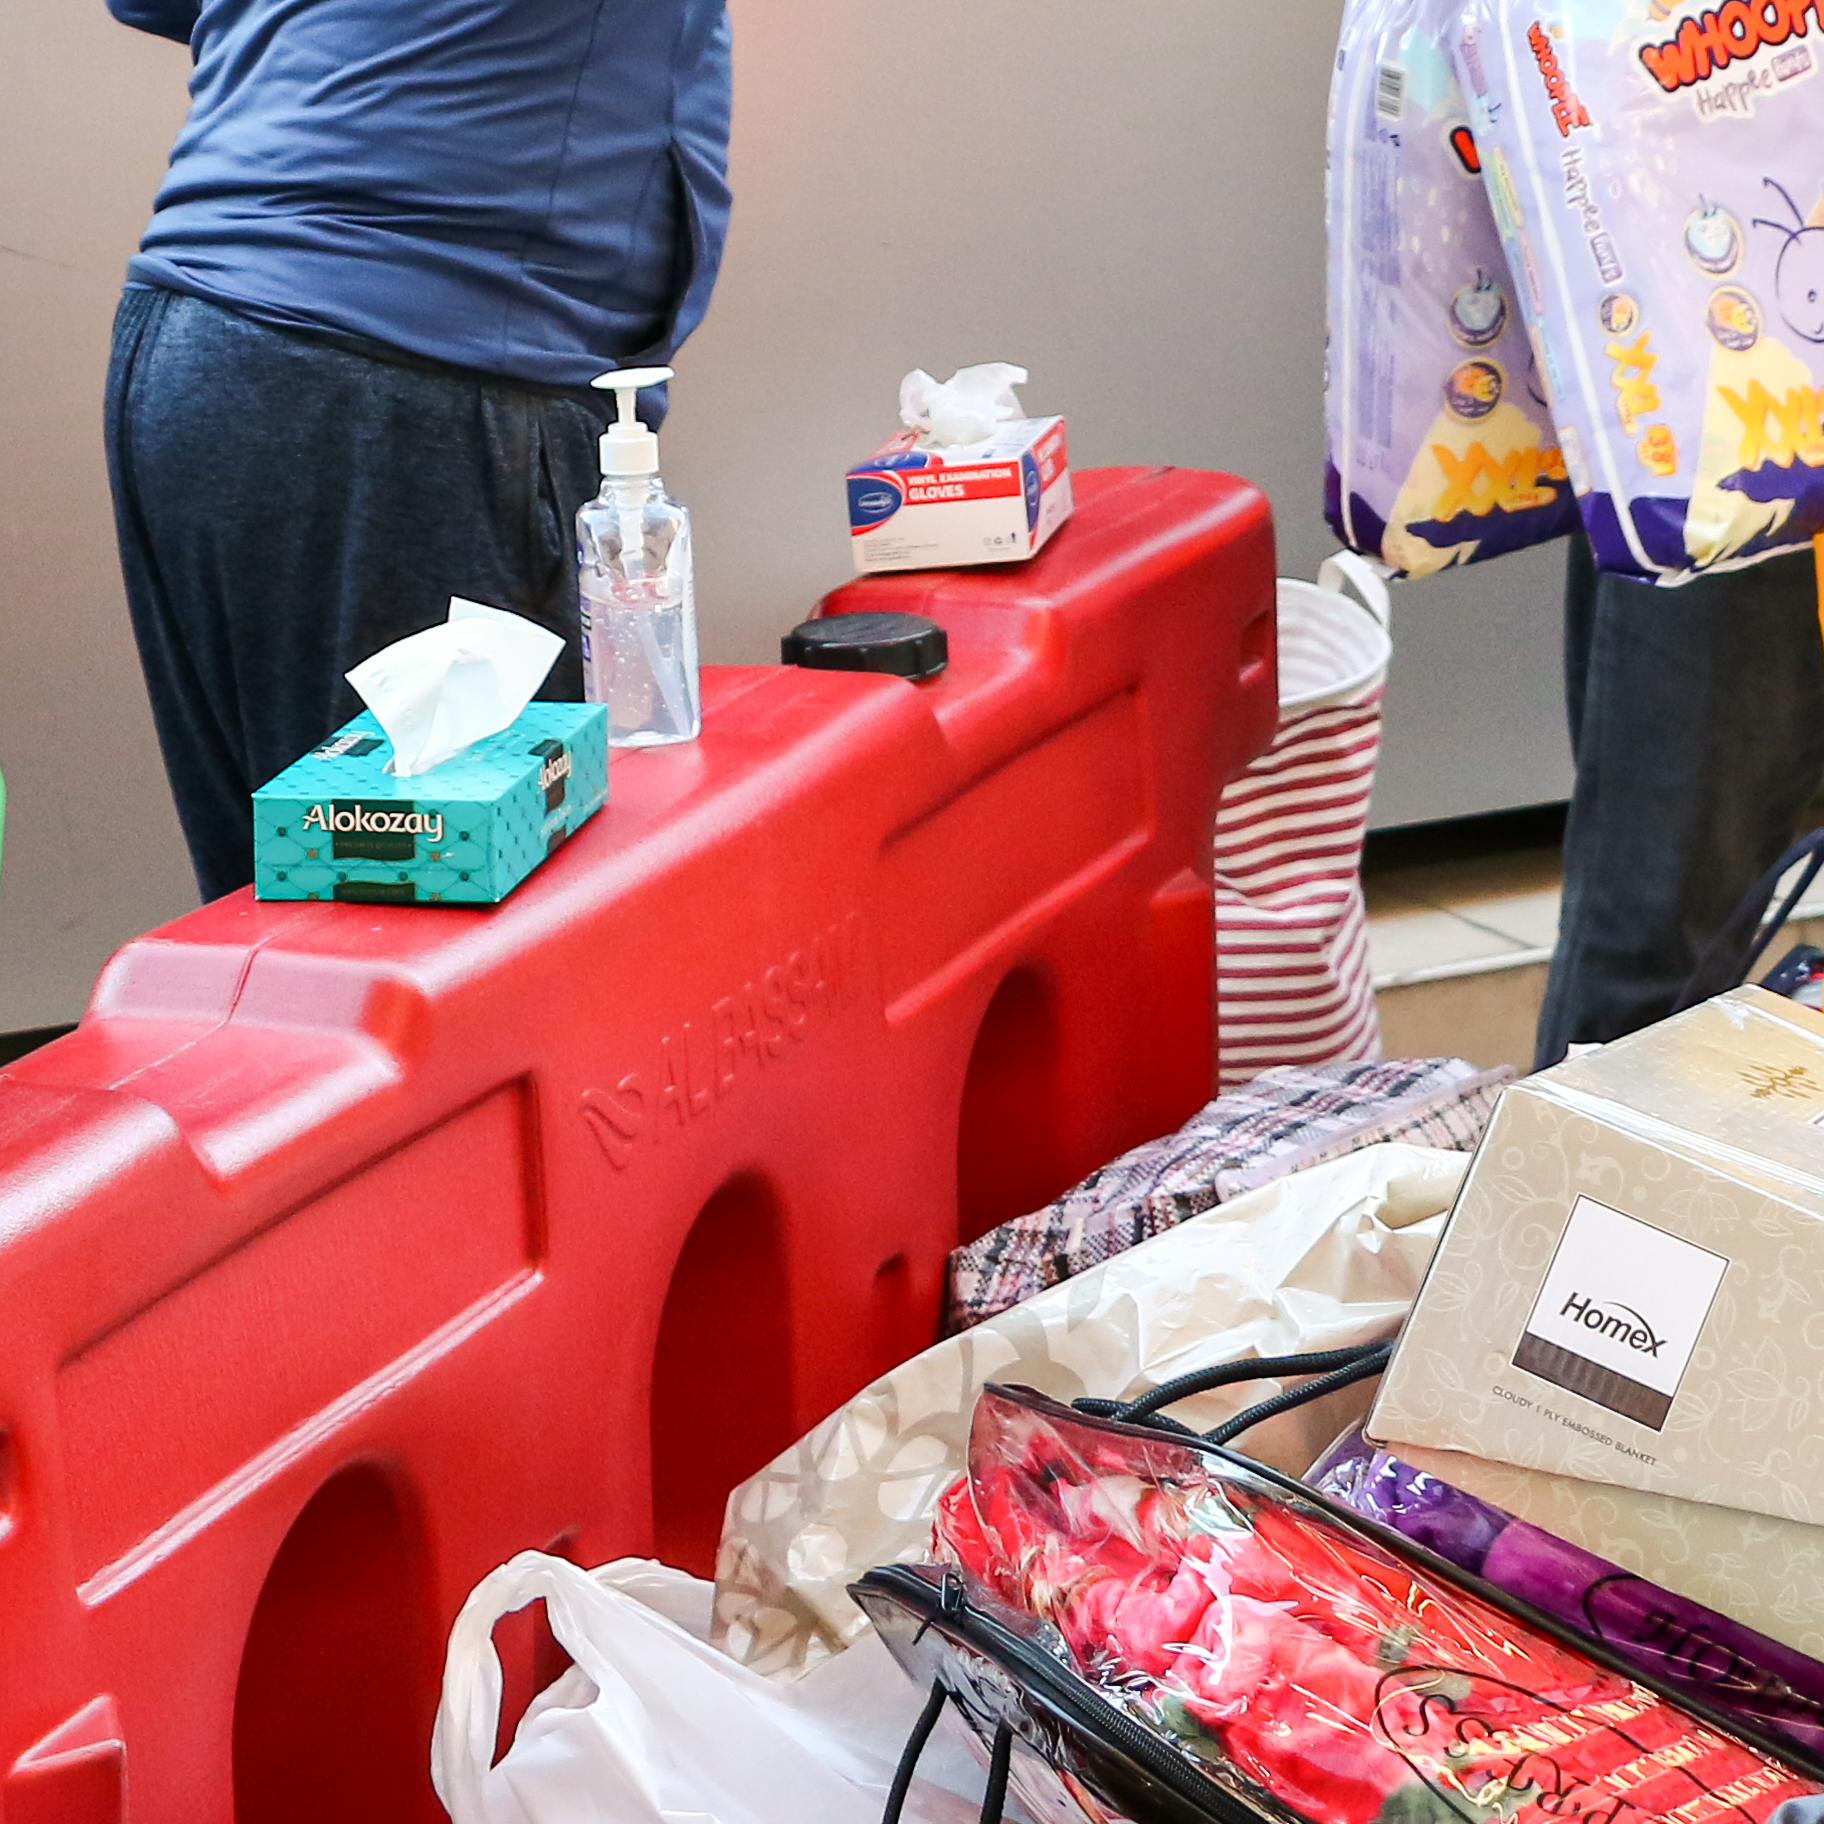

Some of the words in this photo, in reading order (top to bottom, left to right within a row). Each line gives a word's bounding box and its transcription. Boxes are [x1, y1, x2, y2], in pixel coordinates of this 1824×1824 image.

[1527, 21, 1591, 138] WHOOPEE
[907, 475, 937, 484] VINYL
[908, 484, 965, 500] GLOVES
[1431, 440, 1559, 523] XXL
[302, 803, 445, 843] Alokozay
[1559, 1291, 1669, 1359] Homex
[1492, 1385, 1533, 1409] CLOUDY
[1543, 1408, 1562, 1423] PLY
[1562, 1417, 1613, 1446] EMBOSSED
[1615, 1440, 1658, 1467] BLANKET
